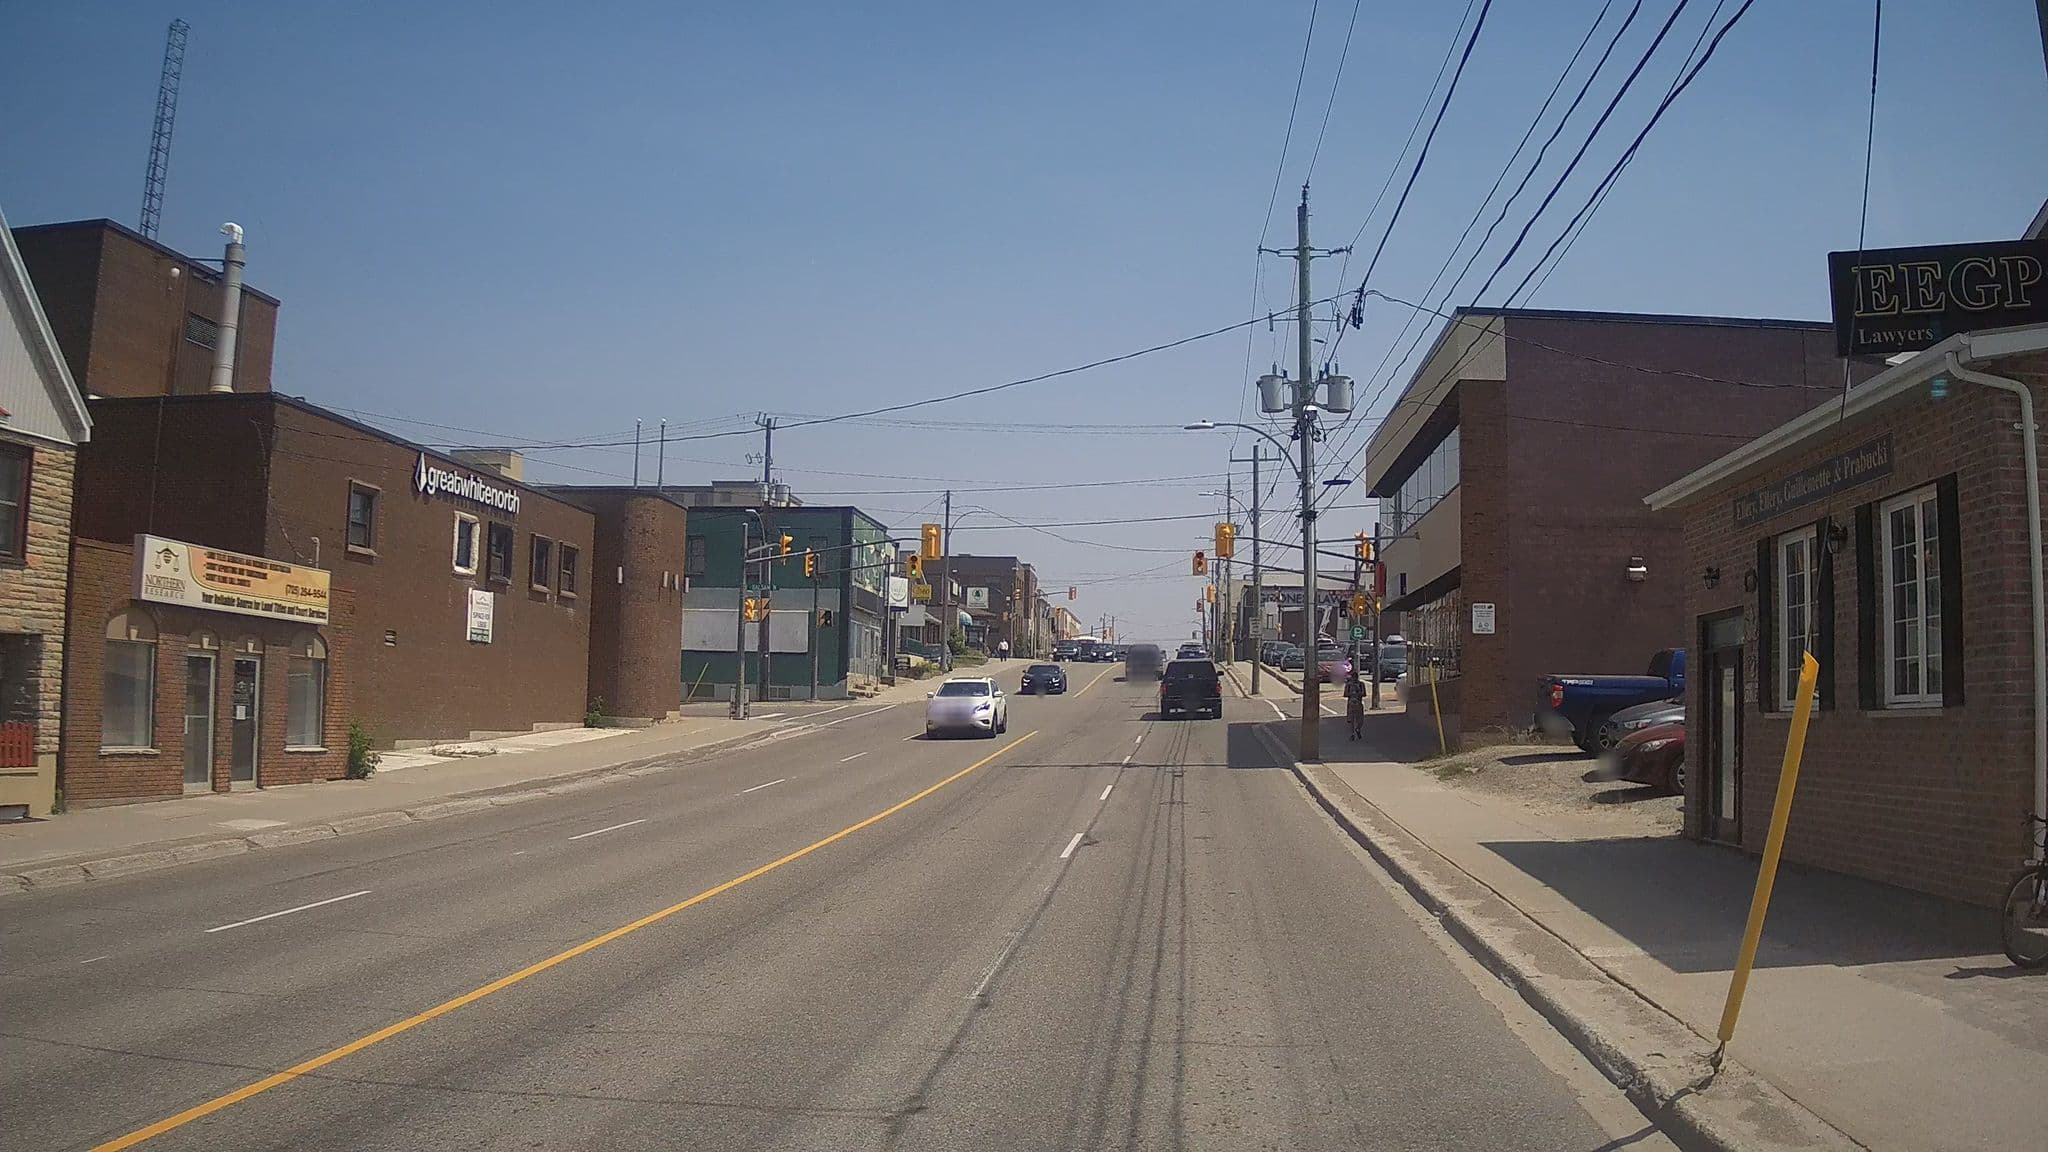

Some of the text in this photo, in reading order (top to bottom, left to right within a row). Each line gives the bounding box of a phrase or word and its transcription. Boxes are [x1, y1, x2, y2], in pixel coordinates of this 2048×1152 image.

[1851, 255, 2043, 317] EEGP
[1858, 327, 1935, 346] Lawyers
[1835, 458, 1841, 481] &
[427, 466, 520, 514] greatwhitenorth
[145, 574, 186, 591] NORTHERN
